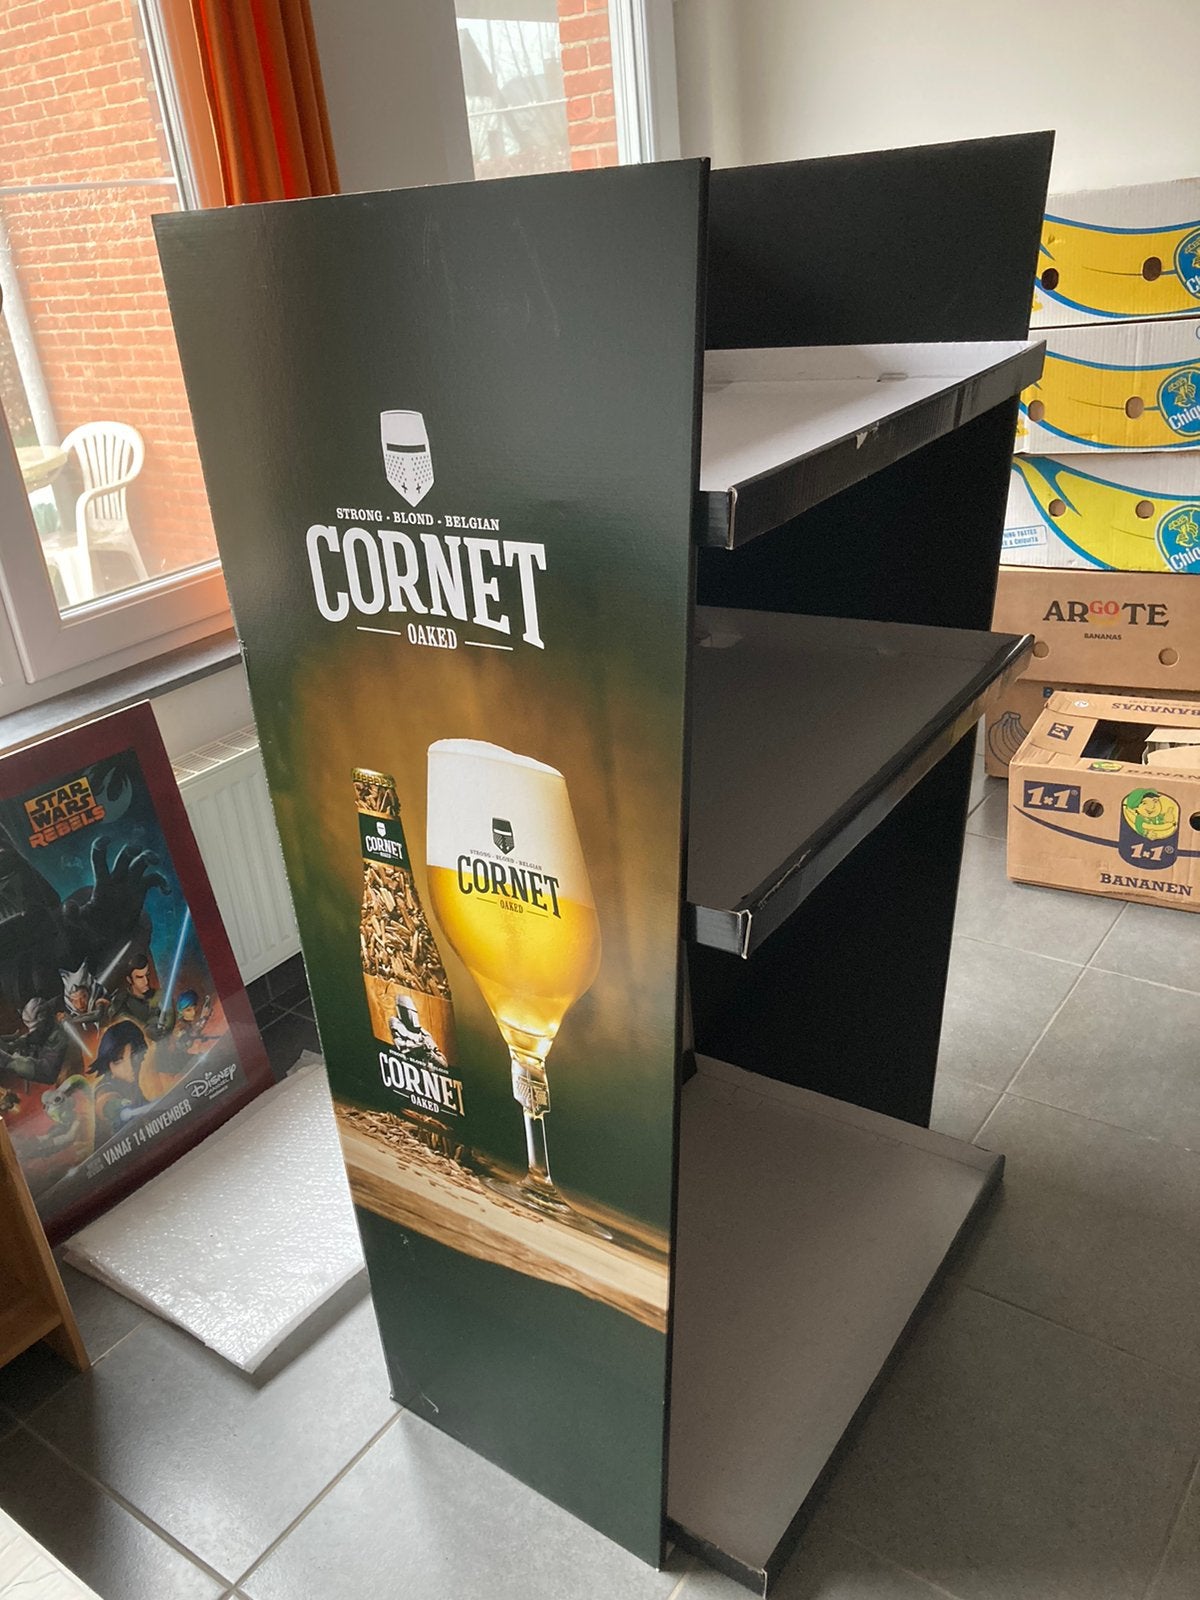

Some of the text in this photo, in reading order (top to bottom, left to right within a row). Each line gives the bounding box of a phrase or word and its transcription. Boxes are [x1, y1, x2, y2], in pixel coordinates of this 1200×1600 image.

[336, 507, 500, 531] STRONG BLOND BELGIAN
[306, 524, 547, 650] CORNET
[407, 623, 457, 649] OAKED
[29, 781, 89, 816] STAR
[32, 793, 92, 829] WARS
[29, 805, 105, 849] REBELS
[365, 835, 403, 860] CORNET
[469, 849, 543, 871] STRONG BLOND BELGIAN
[457, 855, 562, 919] CORNET
[1100, 872, 1193, 896] BANANEN
[500, 899, 524, 914] OAKED
[379, 1052, 465, 1117] CORNET
[410, 1094, 440, 1113] OAKED
[103, 1099, 192, 1166] VANAF 14 NOVEMBER
